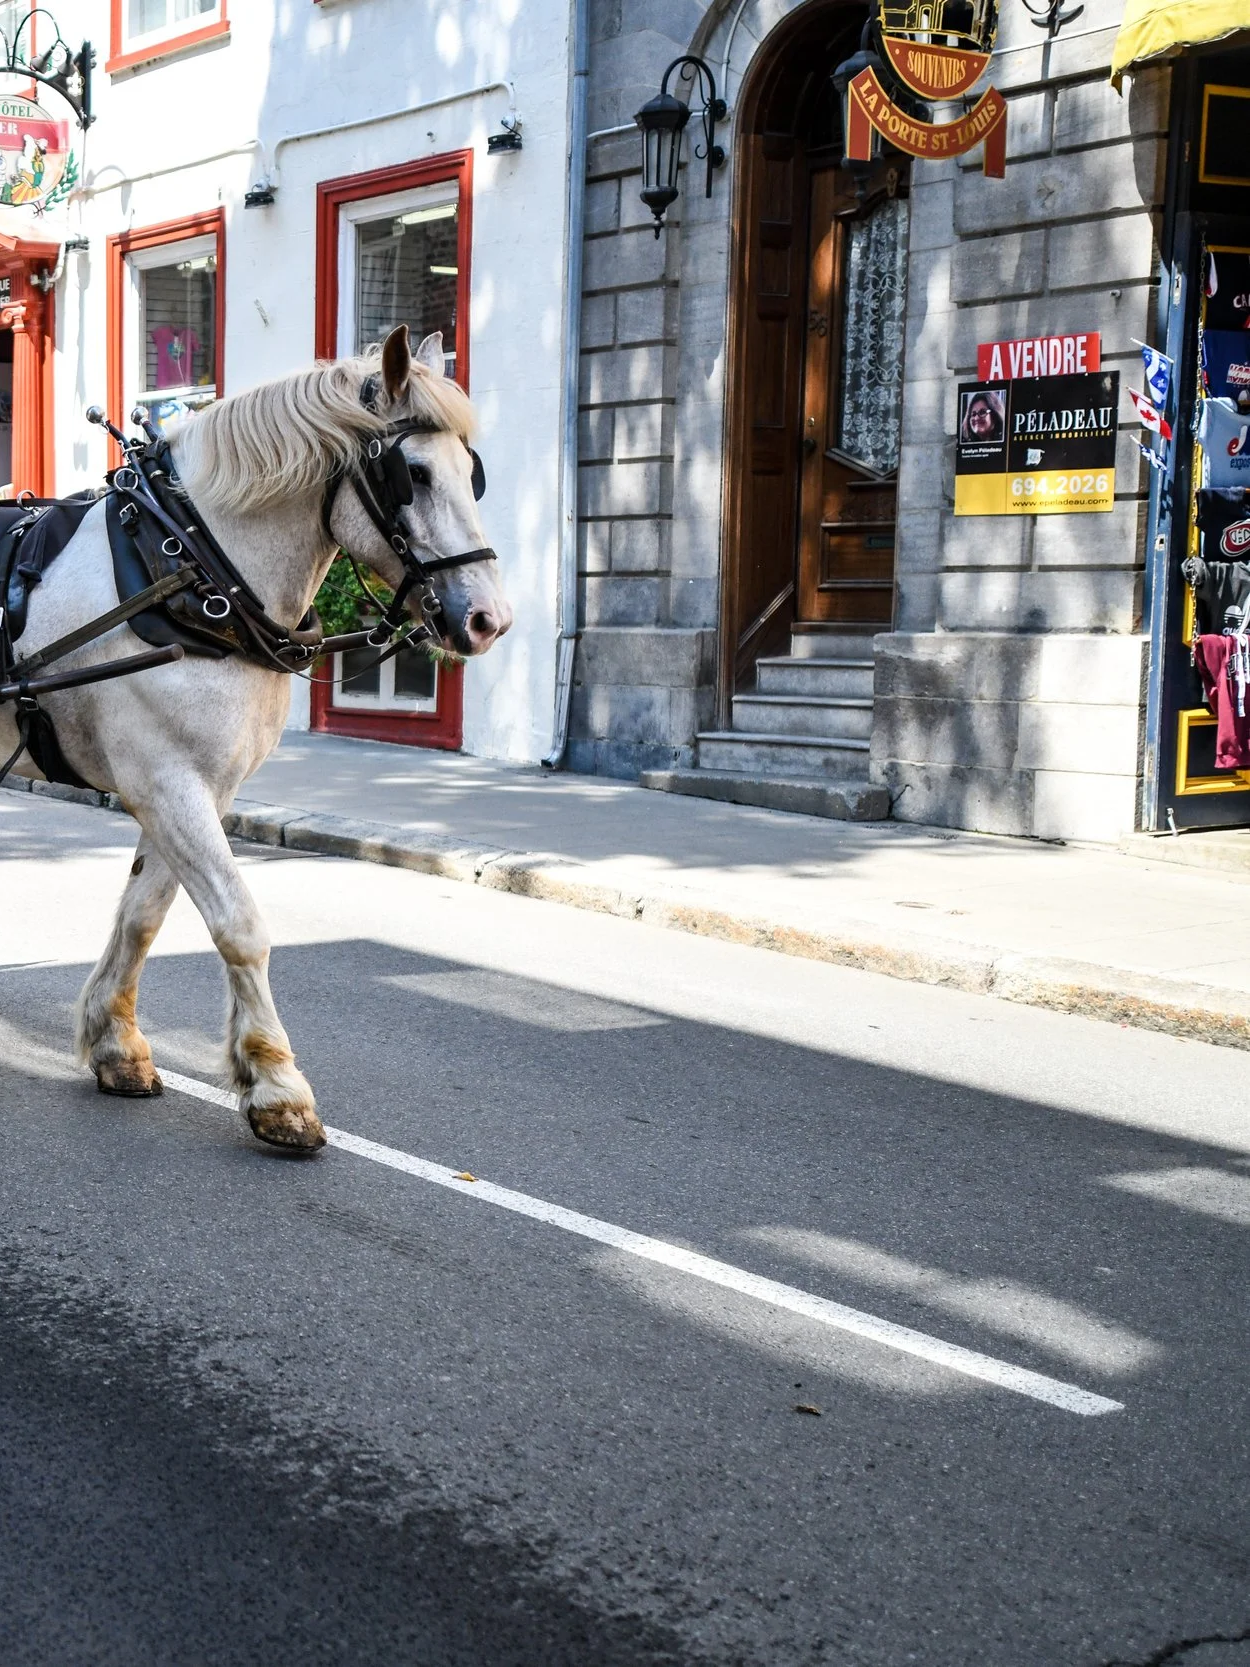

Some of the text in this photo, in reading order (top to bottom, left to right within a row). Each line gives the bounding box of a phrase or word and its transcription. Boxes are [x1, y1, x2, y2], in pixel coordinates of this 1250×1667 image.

[907, 49, 967, 89] SOUVENIRS
[859, 79, 879, 112] LA
[877, 105, 928, 149] PORTE
[989, 335, 1087, 381] A VENDRE
[1014, 407, 1112, 433] PÉLADEAU
[1012, 474, 1108, 496] 694.2026
